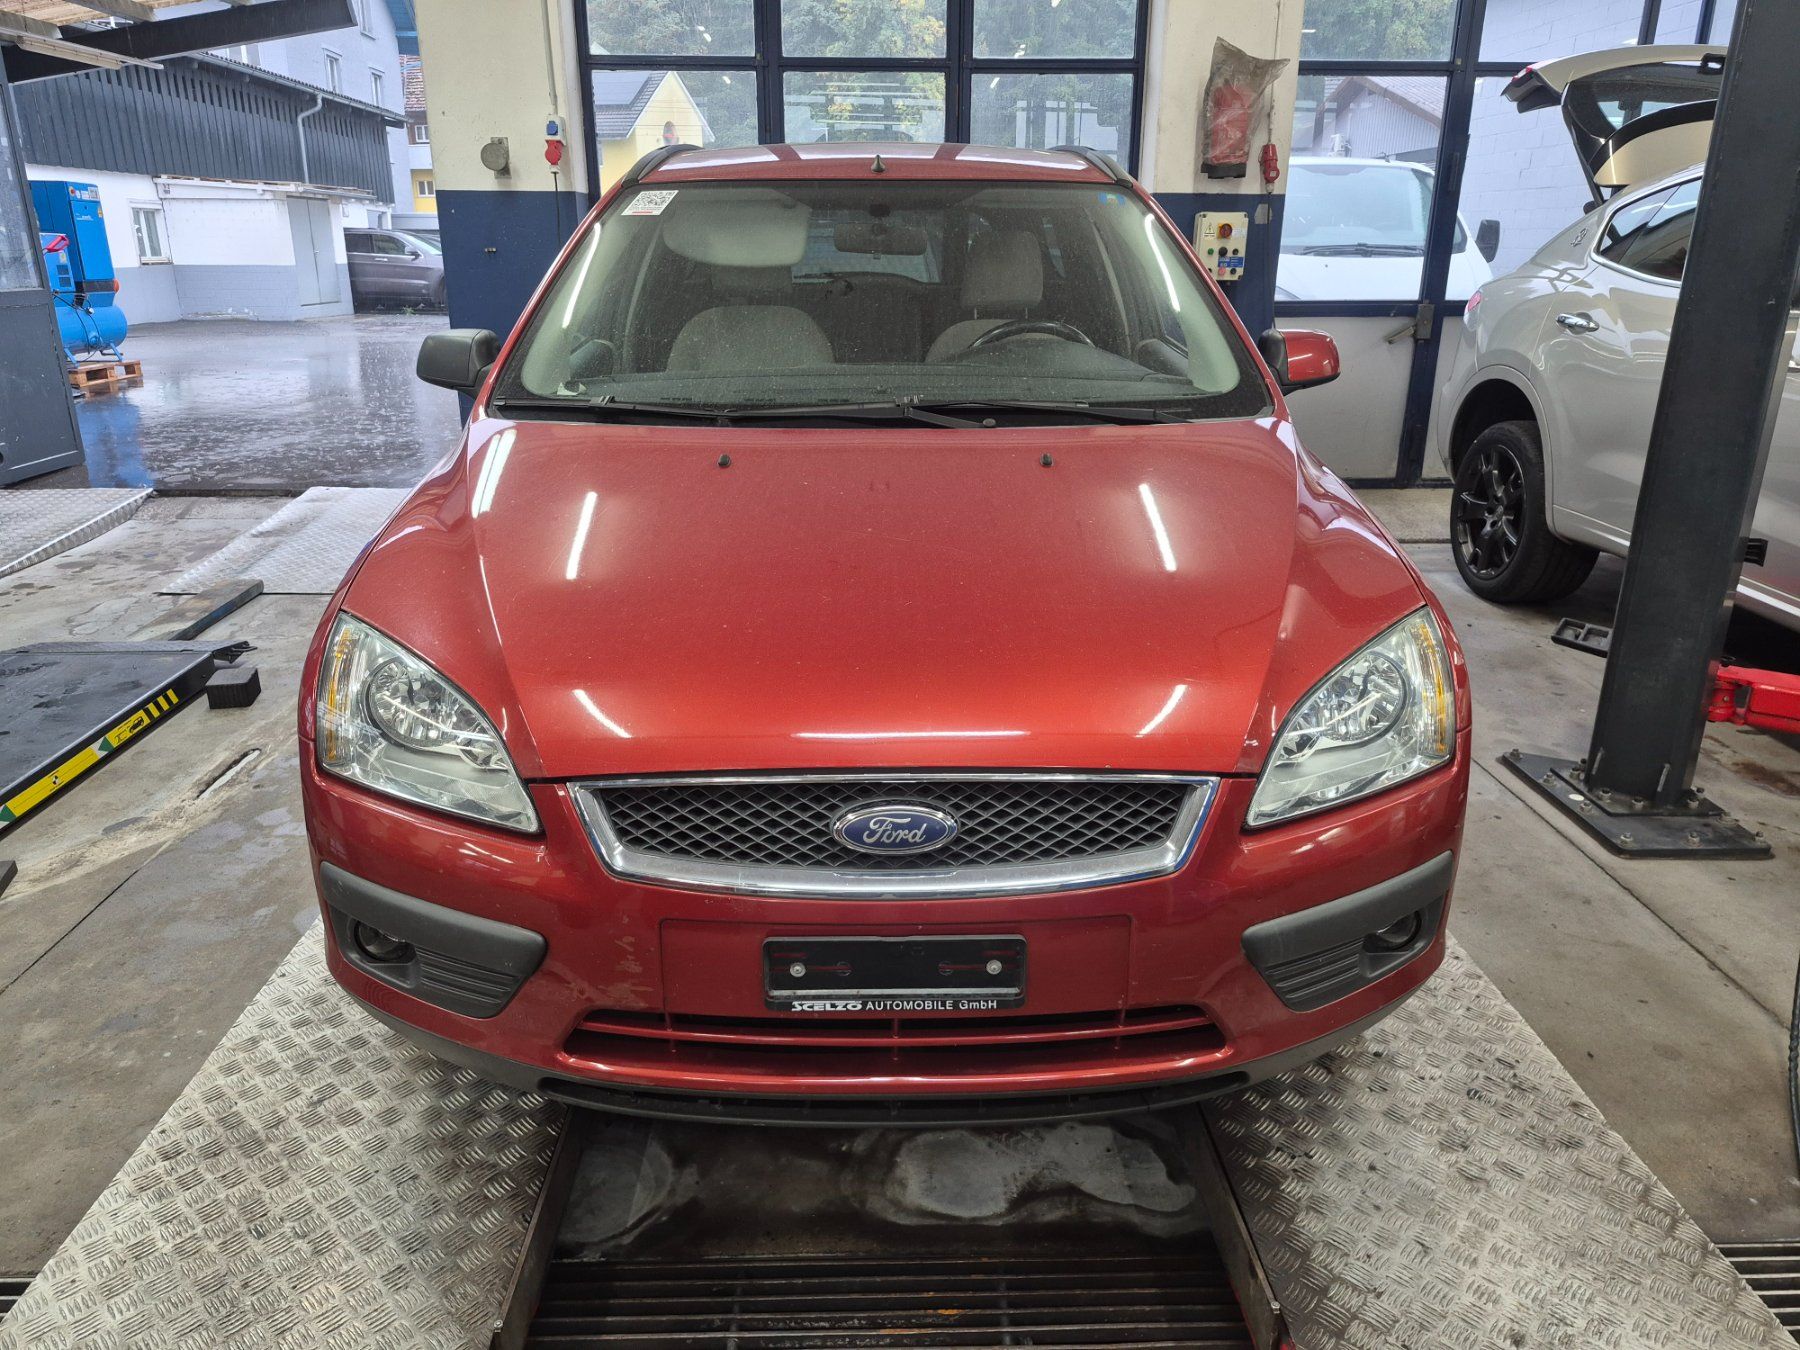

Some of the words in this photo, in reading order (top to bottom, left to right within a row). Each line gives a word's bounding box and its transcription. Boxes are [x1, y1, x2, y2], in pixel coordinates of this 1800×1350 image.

[862, 816, 928, 844] Ford
[792, 1001, 863, 1012] SCELZO
[865, 1000, 954, 1011] AUTOMOBILE
[959, 1000, 998, 1010] GmbH
